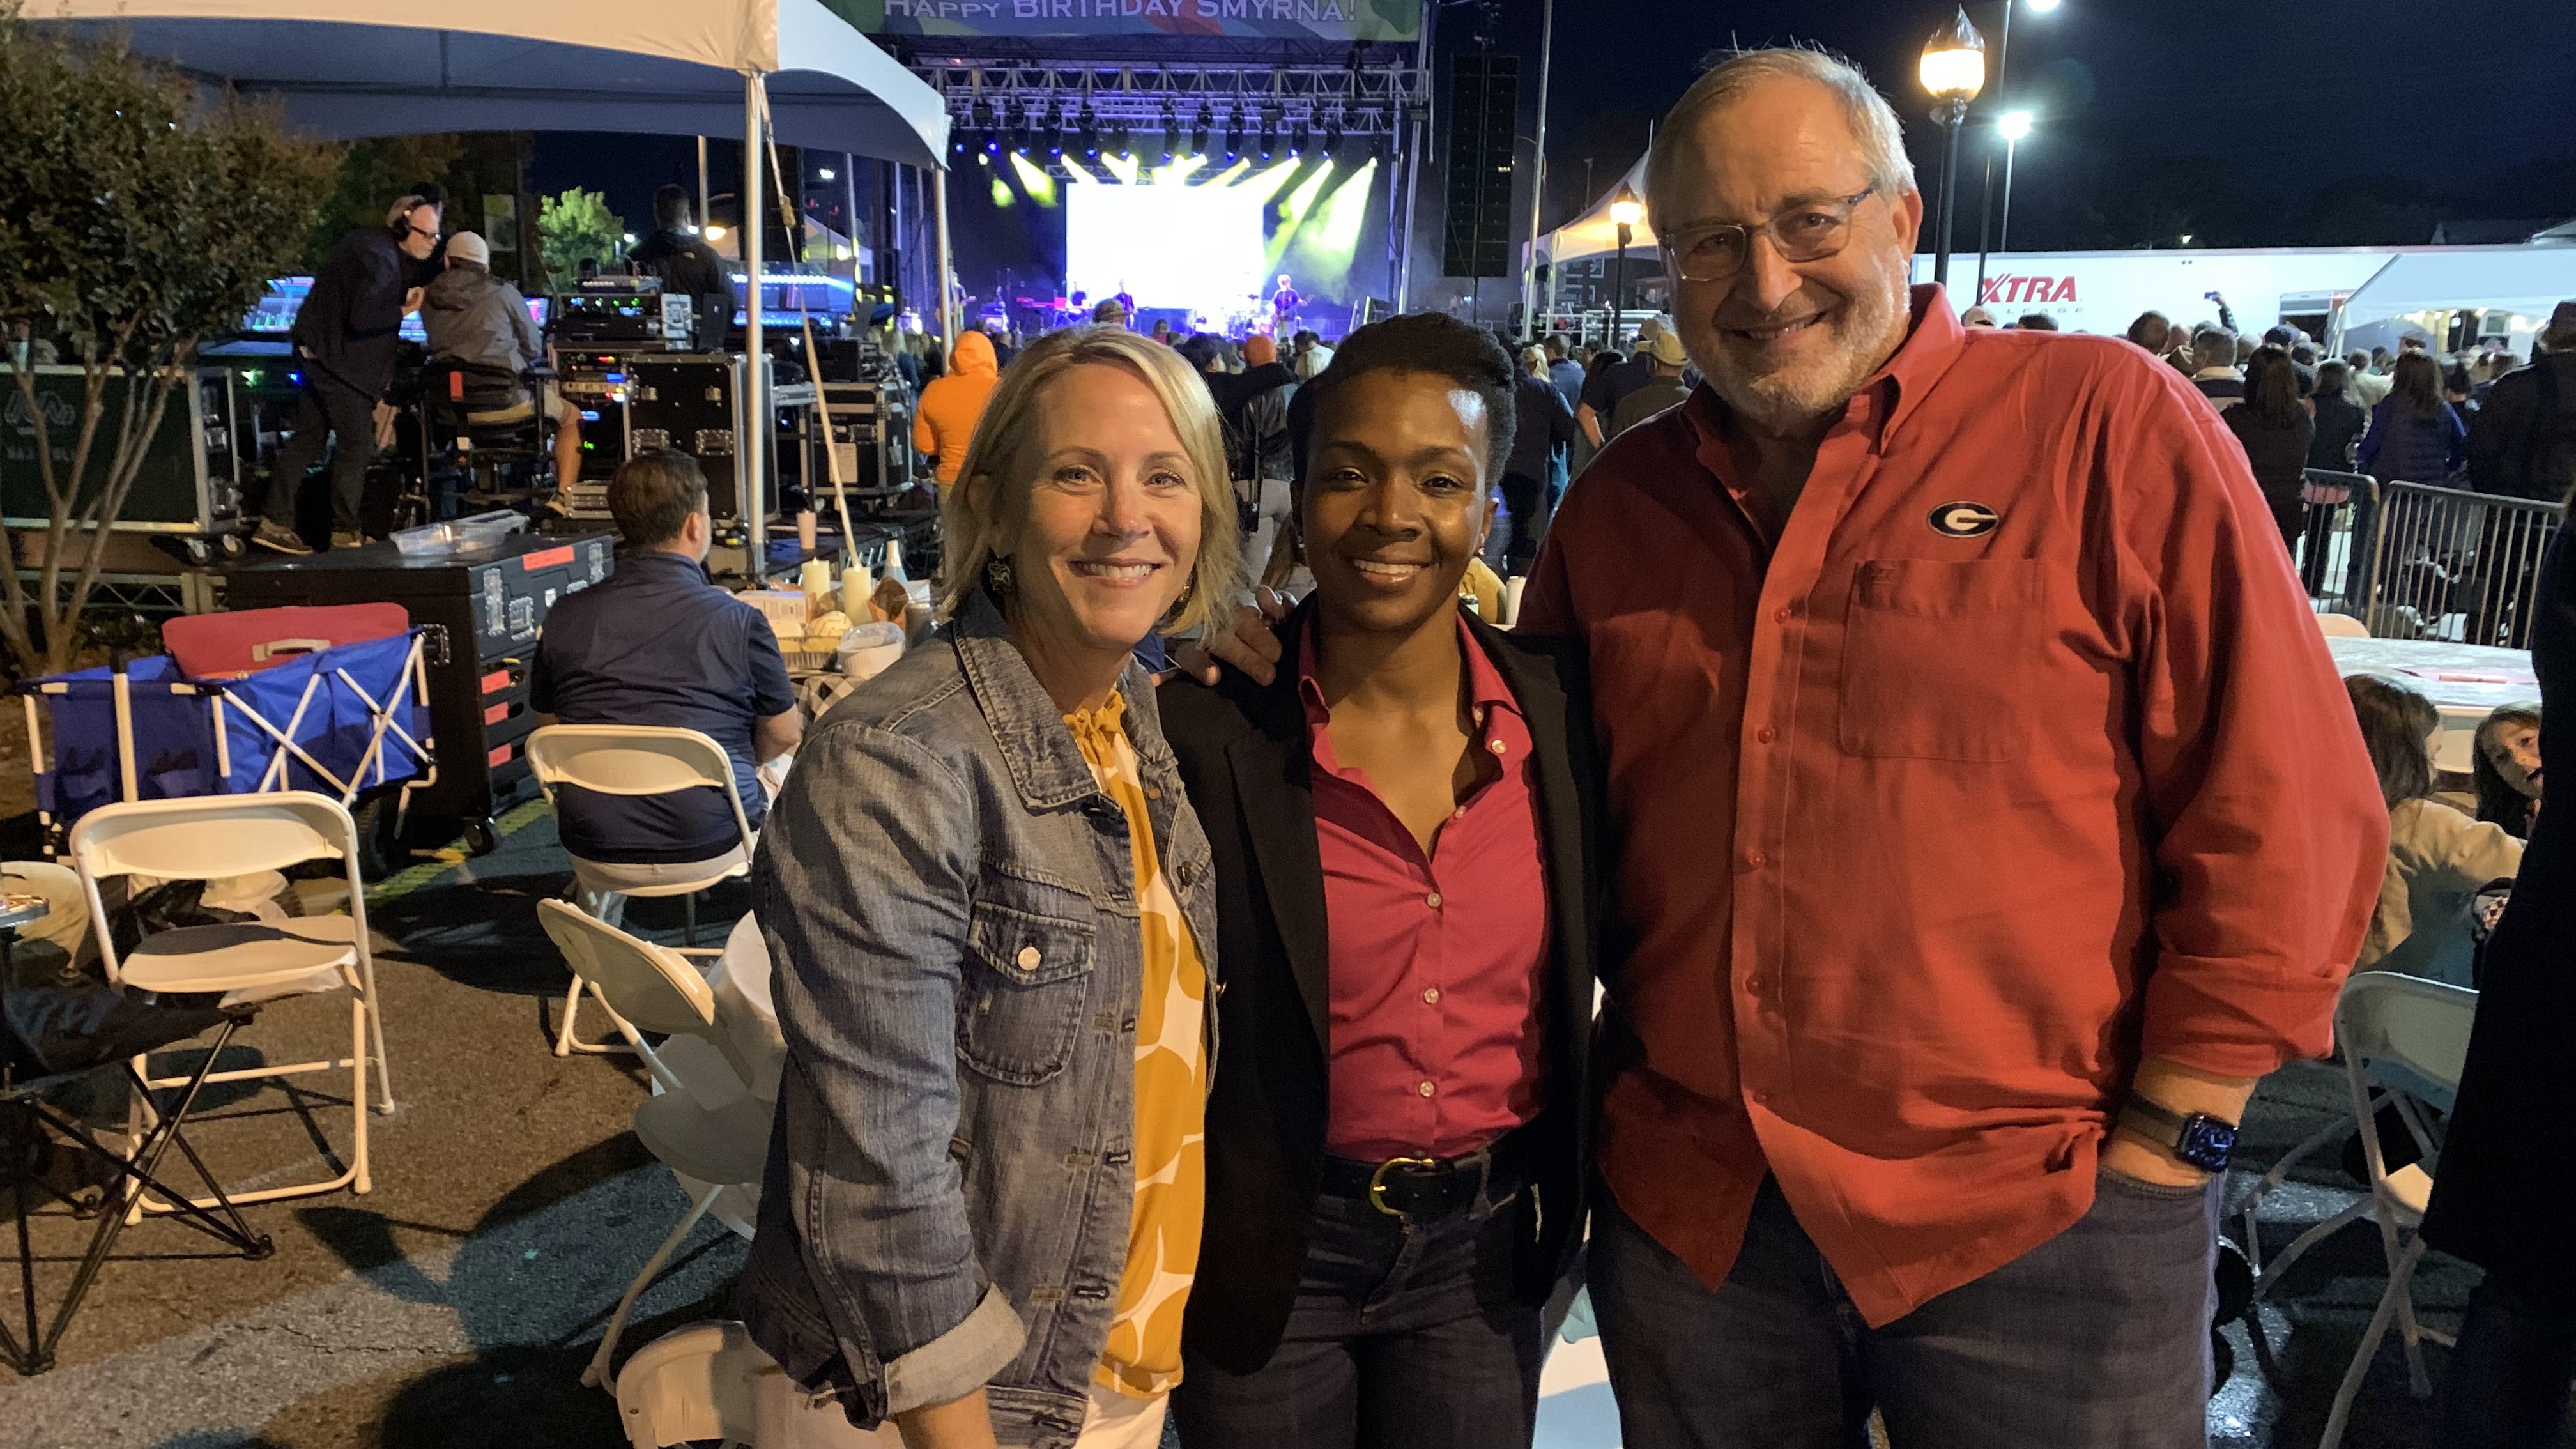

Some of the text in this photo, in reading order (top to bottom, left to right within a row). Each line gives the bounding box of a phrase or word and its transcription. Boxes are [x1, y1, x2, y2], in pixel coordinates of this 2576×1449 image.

[884, 0, 1356, 22] HAPPY BIRTHDAY SMYRNA!
[1982, 274, 2076, 303] XTRA
